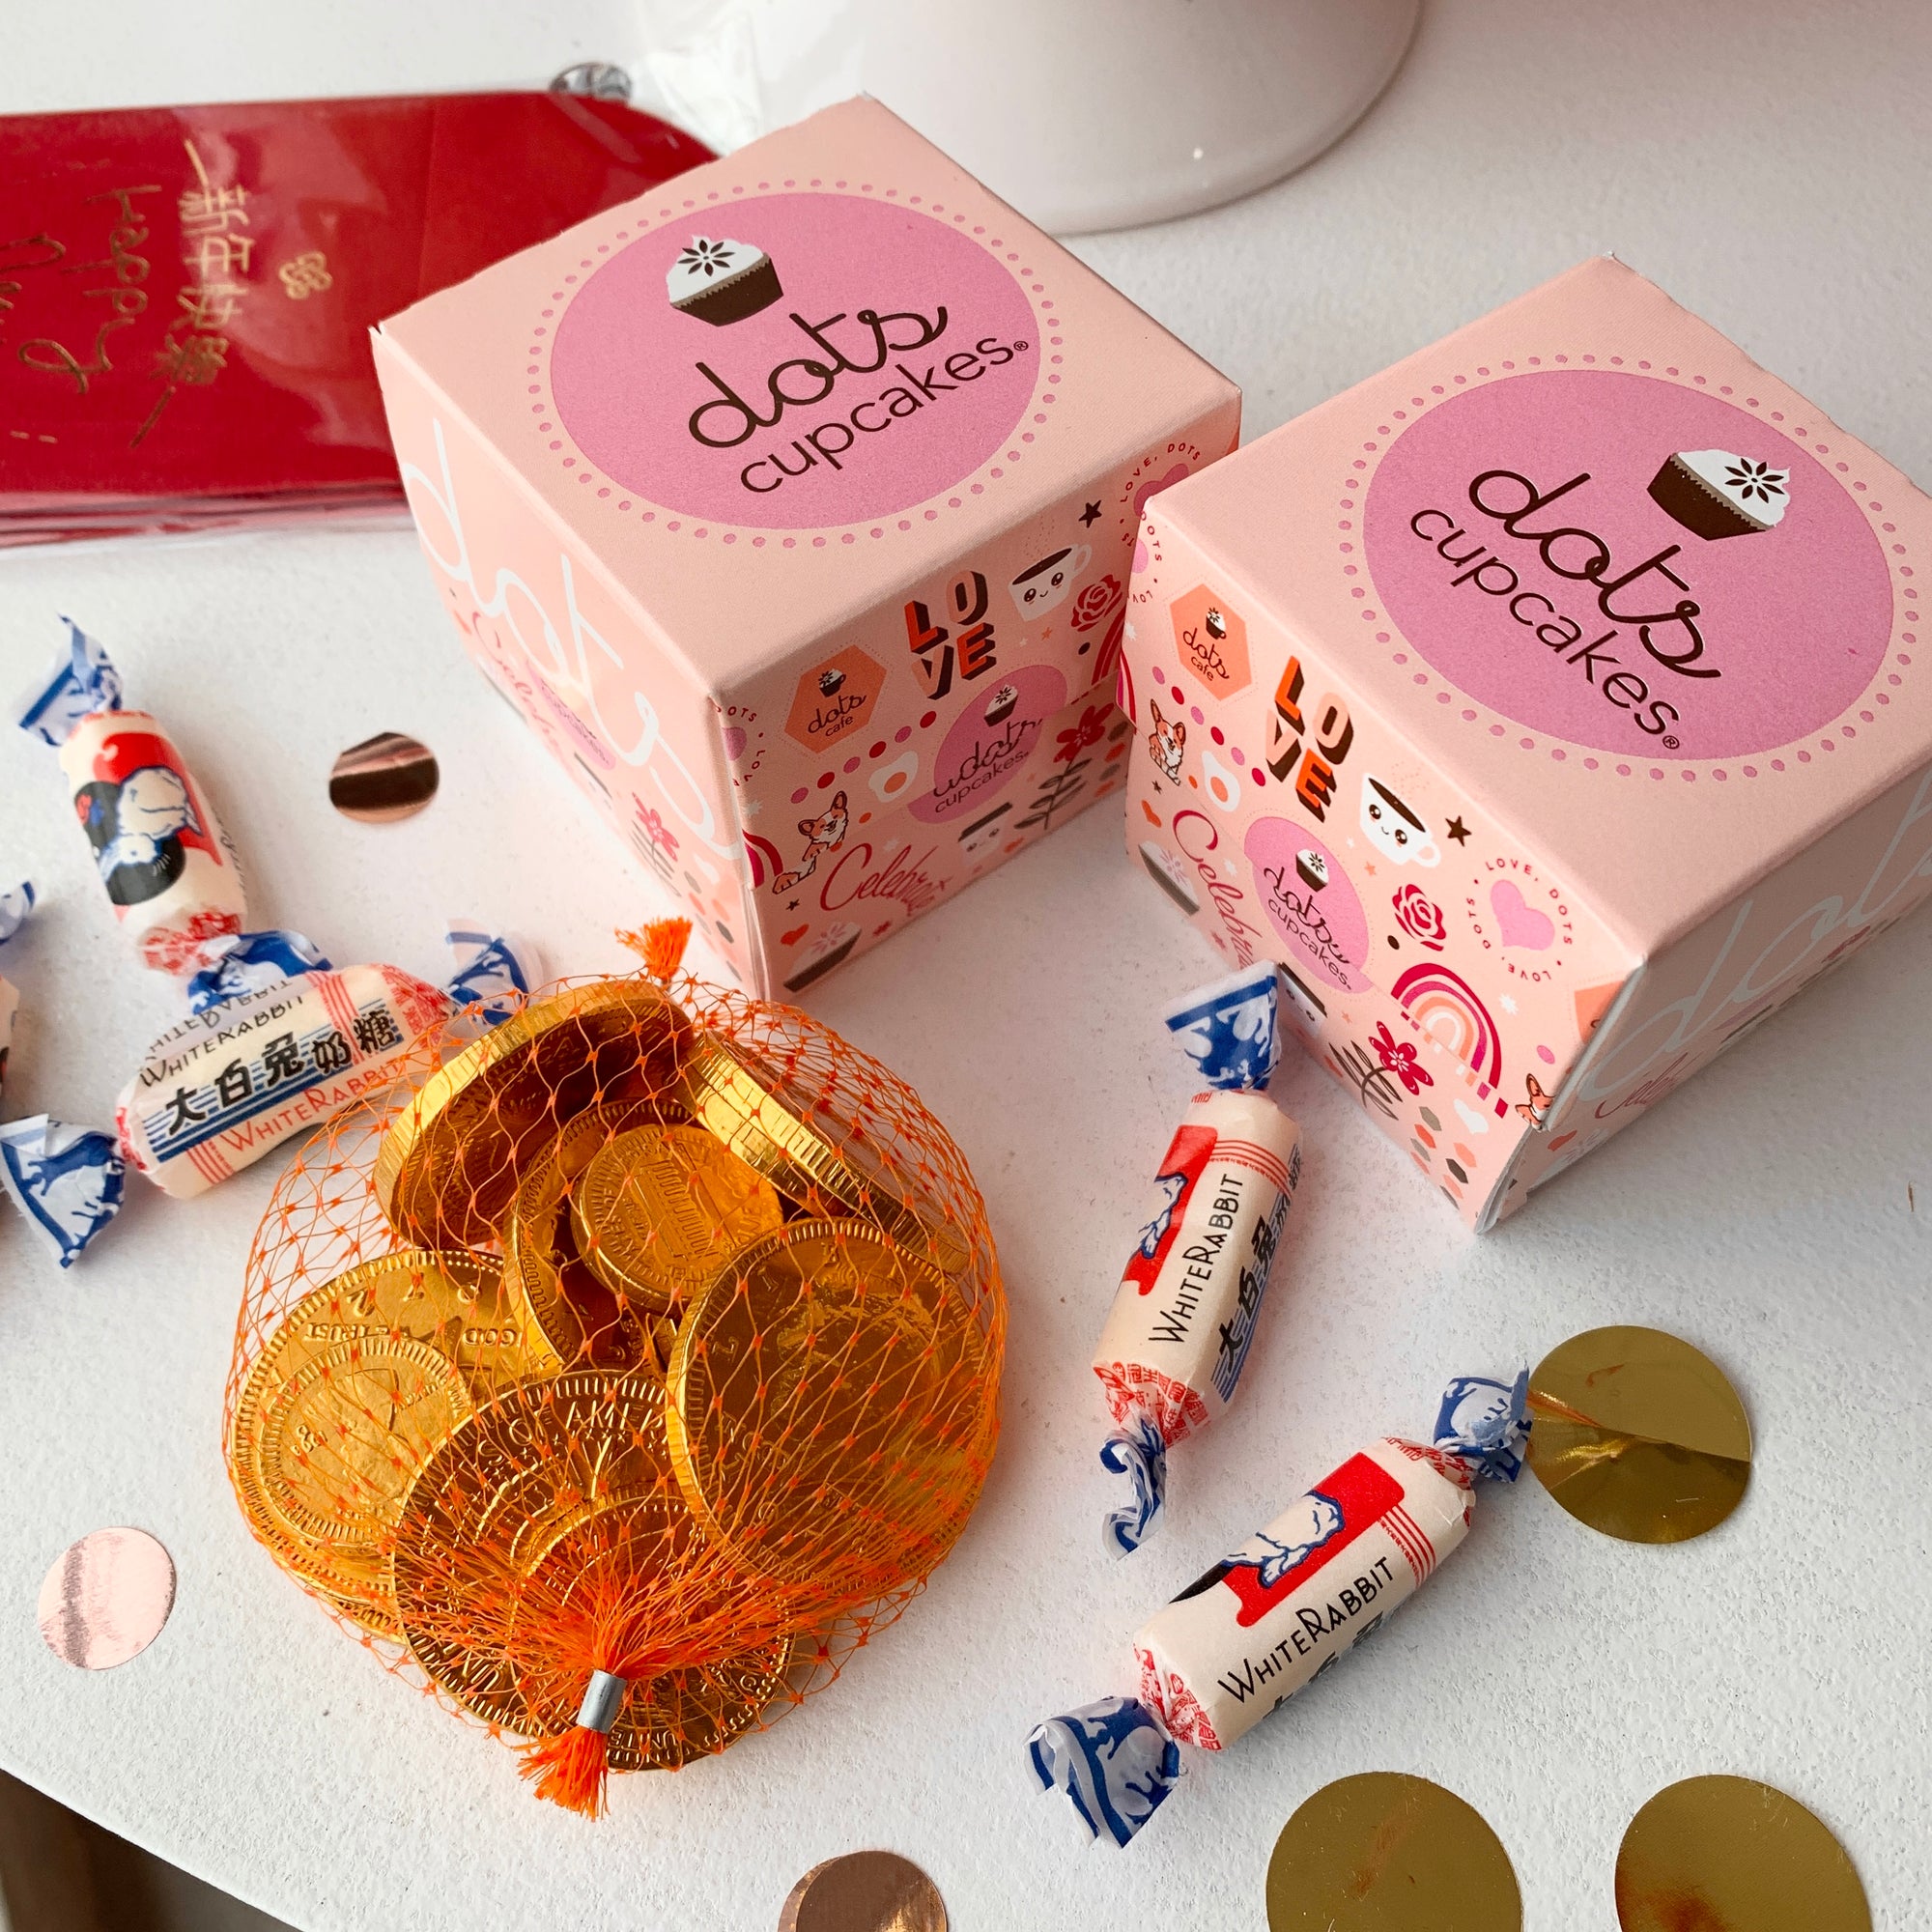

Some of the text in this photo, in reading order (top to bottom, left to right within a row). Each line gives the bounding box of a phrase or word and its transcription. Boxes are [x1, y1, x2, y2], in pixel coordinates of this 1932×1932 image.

[689, 306, 949, 448] dots
[1167, 442, 1201, 461] DOTS
[1468, 469, 1722, 678] dots
[1182, 627, 1230, 680] dots
[1190, 656, 1214, 682] cafe
[808, 692, 867, 735] dots
[825, 713, 854, 737] cafe
[1548, 888, 1574, 946] DOTS
[166, 1009, 396, 1136] 大白兔奶糖
[462, 1327, 518, 1347] GOD
[565, 1400, 665, 1435] AMER
[610, 1730, 679, 1753] UNITE
